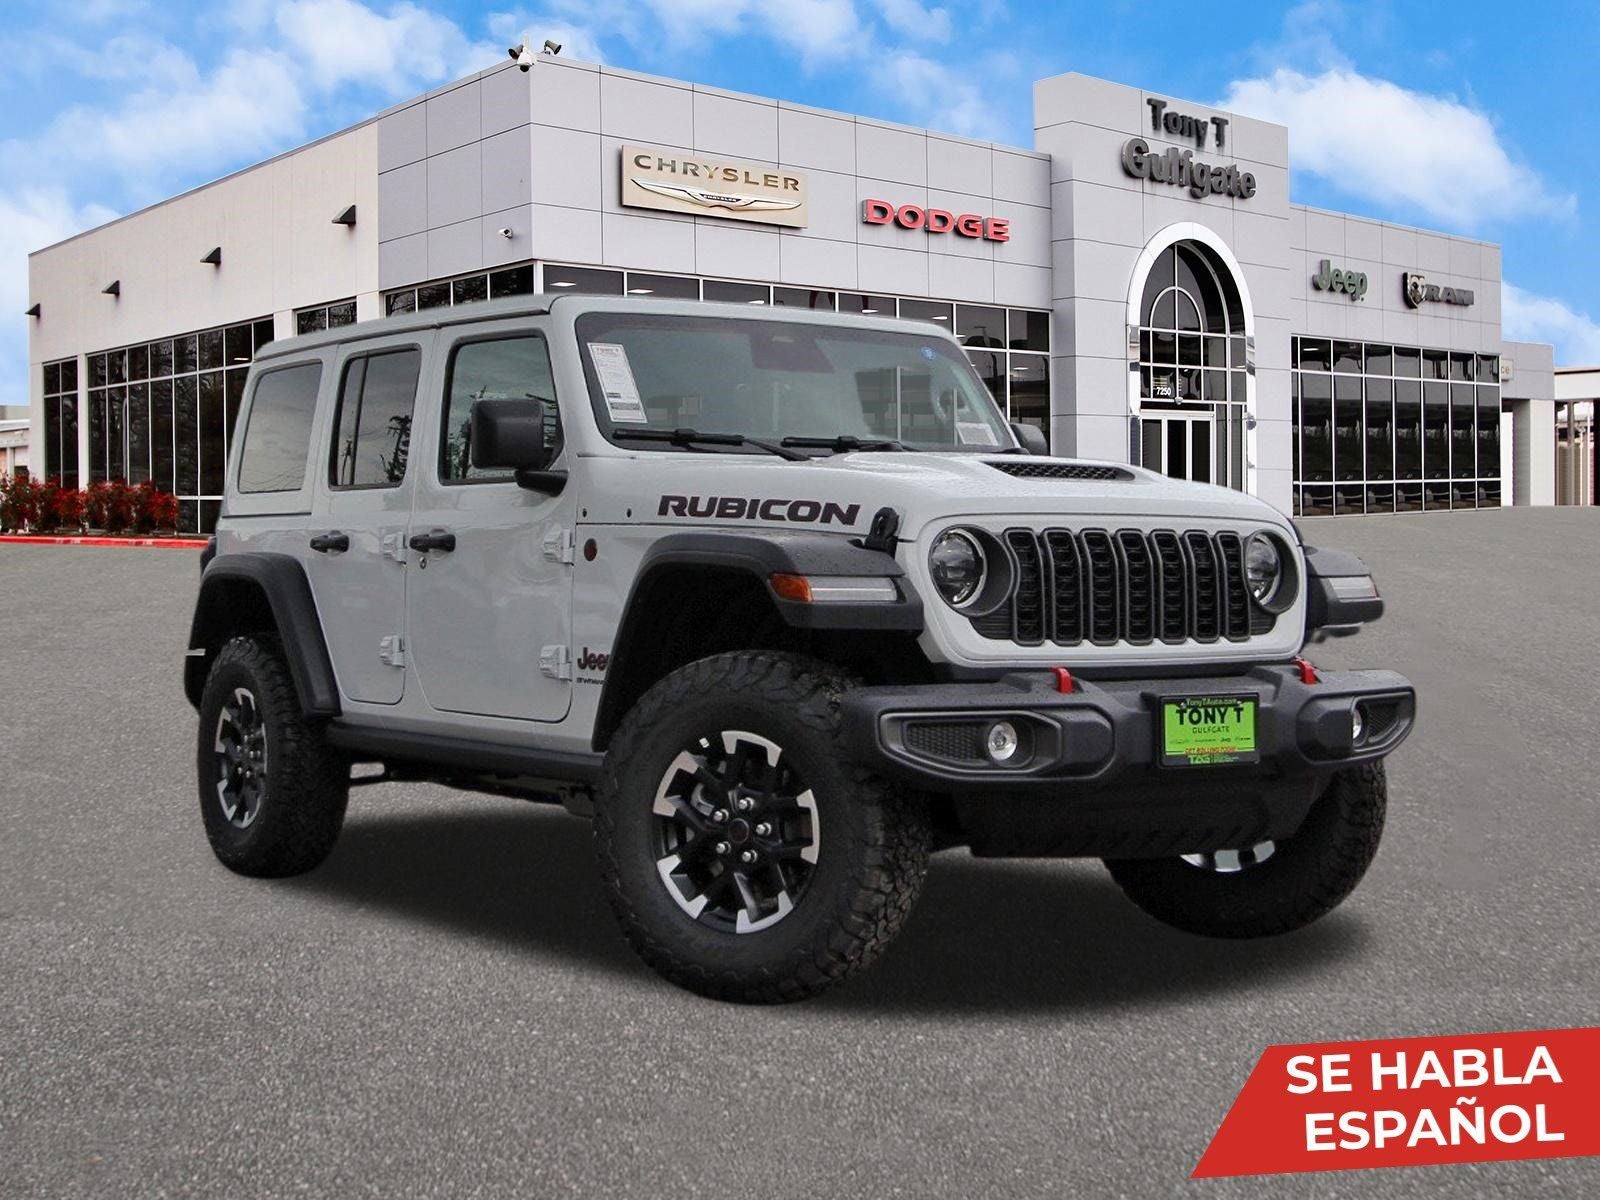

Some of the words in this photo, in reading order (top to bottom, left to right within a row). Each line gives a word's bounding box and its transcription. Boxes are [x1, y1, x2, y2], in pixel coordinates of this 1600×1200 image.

[1147, 98, 1208, 147] Tony
[1210, 116, 1229, 148] T
[633, 154, 800, 192] CHRYSLER
[1121, 137, 1257, 199] Gulfgate
[862, 198, 1010, 242] DODGE
[1312, 259, 1368, 302] Jeep
[1424, 284, 1475, 307] RAM
[1156, 386, 1172, 396] 7250
[657, 494, 861, 526] RUBICON
[1176, 706, 1228, 725] TONY
[1233, 706, 1244, 723] T
[1192, 726, 1230, 734] GULFGATE
